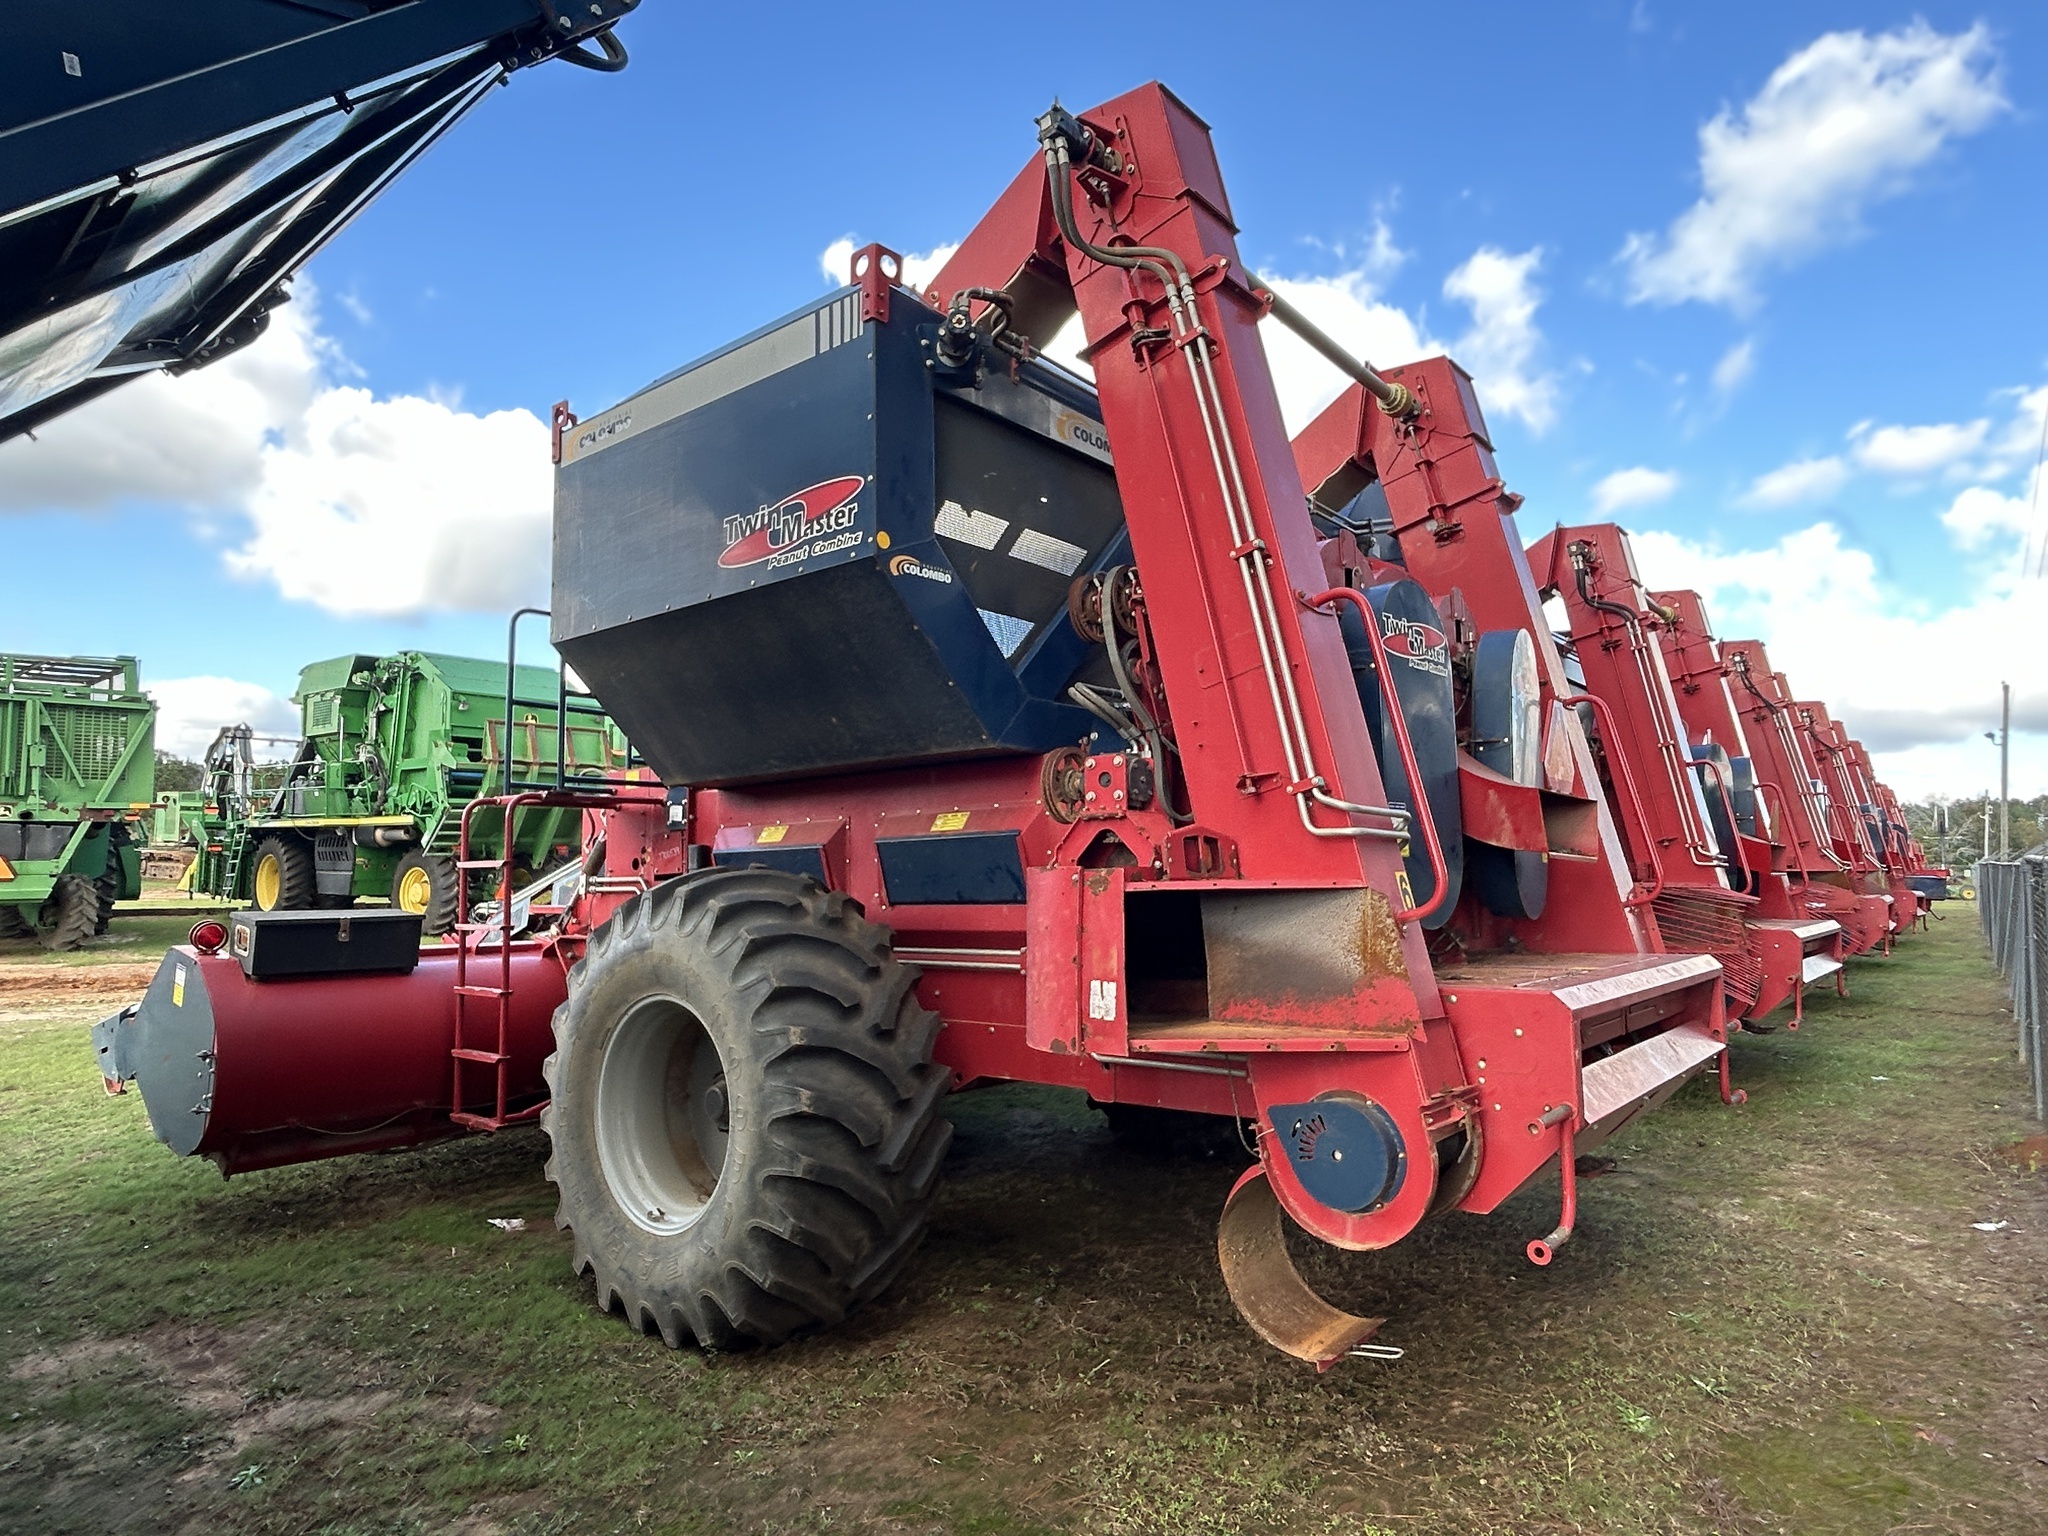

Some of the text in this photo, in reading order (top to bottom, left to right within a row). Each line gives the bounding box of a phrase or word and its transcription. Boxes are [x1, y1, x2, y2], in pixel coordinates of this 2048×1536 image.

[724, 503, 858, 545] Twin Master
[767, 532, 863, 570] Peanut Combine
[903, 563, 953, 584] COLOMBO
[1382, 612, 1413, 640] Twin
